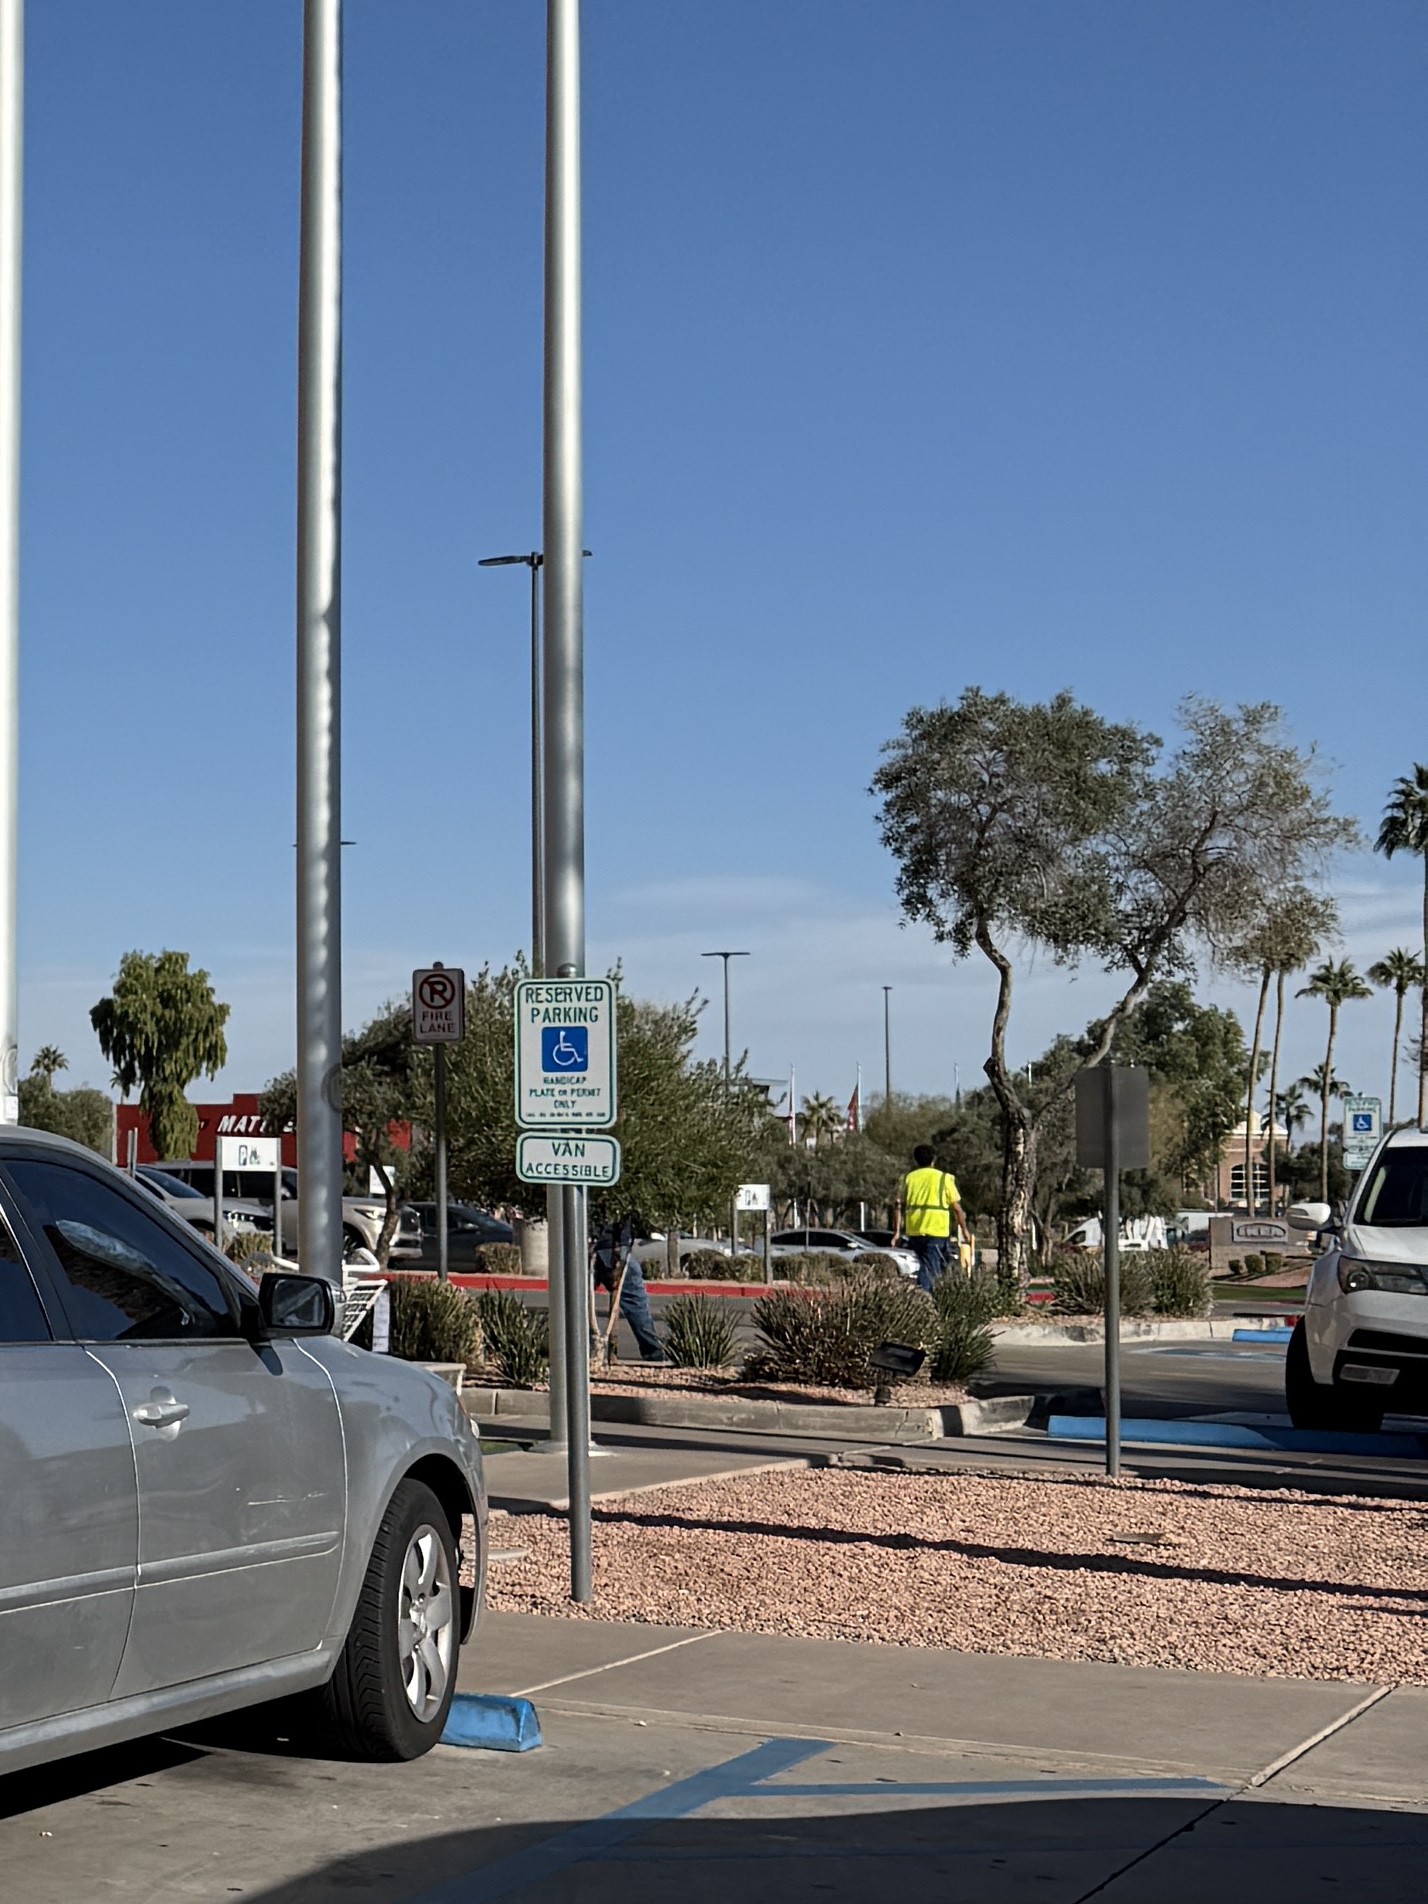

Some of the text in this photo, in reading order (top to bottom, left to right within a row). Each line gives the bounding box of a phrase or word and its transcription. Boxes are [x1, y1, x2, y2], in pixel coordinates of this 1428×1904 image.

[525, 986, 604, 1004] RESERVED
[422, 1010, 453, 1022] FIRE
[531, 1007, 599, 1024] PARKING
[420, 1022, 455, 1034] LANE
[543, 1076, 587, 1085] HANDICAP
[529, 1088, 555, 1098] PLATE
[570, 1088, 602, 1098] PERMIT
[554, 1099, 577, 1109] ONLY
[551, 1142, 586, 1158] VAN
[525, 1163, 610, 1178] ACCESSIBLE
